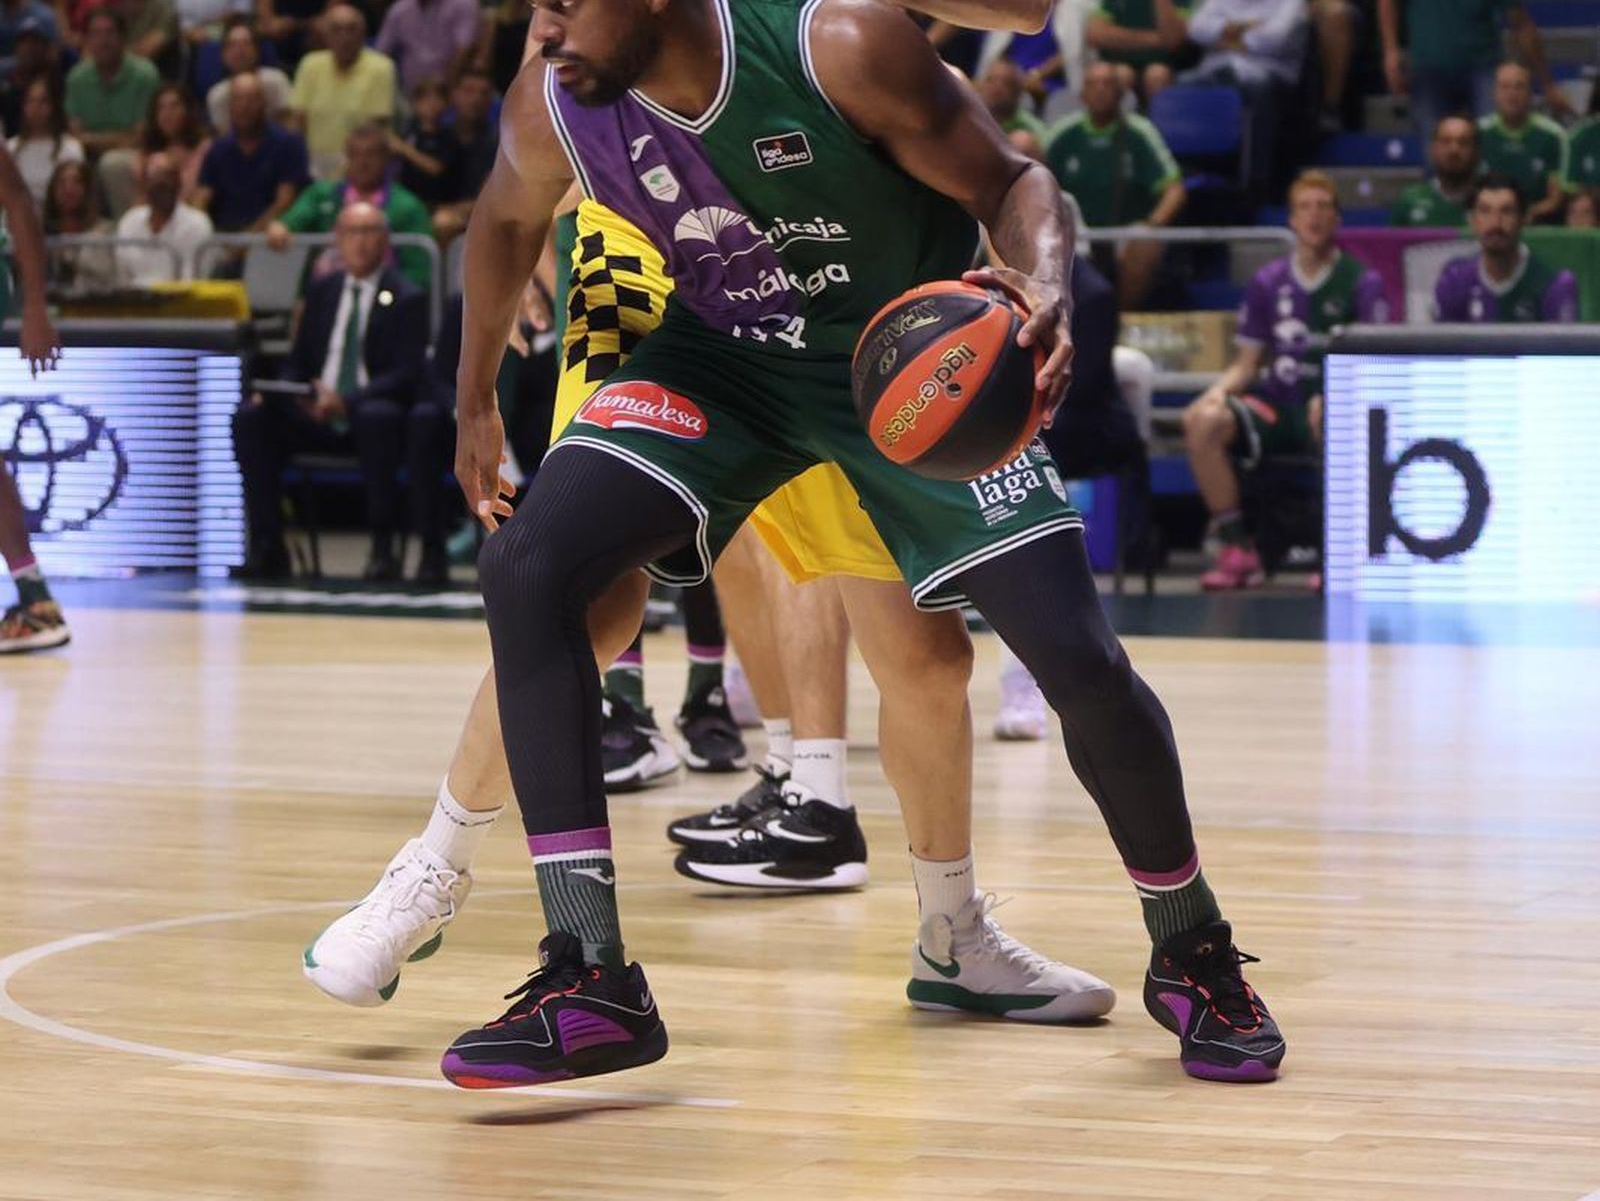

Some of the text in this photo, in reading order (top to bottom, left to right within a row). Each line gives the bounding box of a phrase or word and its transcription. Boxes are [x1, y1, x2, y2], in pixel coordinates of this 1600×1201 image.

[934, 341, 978, 386] liga
[967, 468, 1044, 511] laga
[1368, 408, 1491, 562] b
